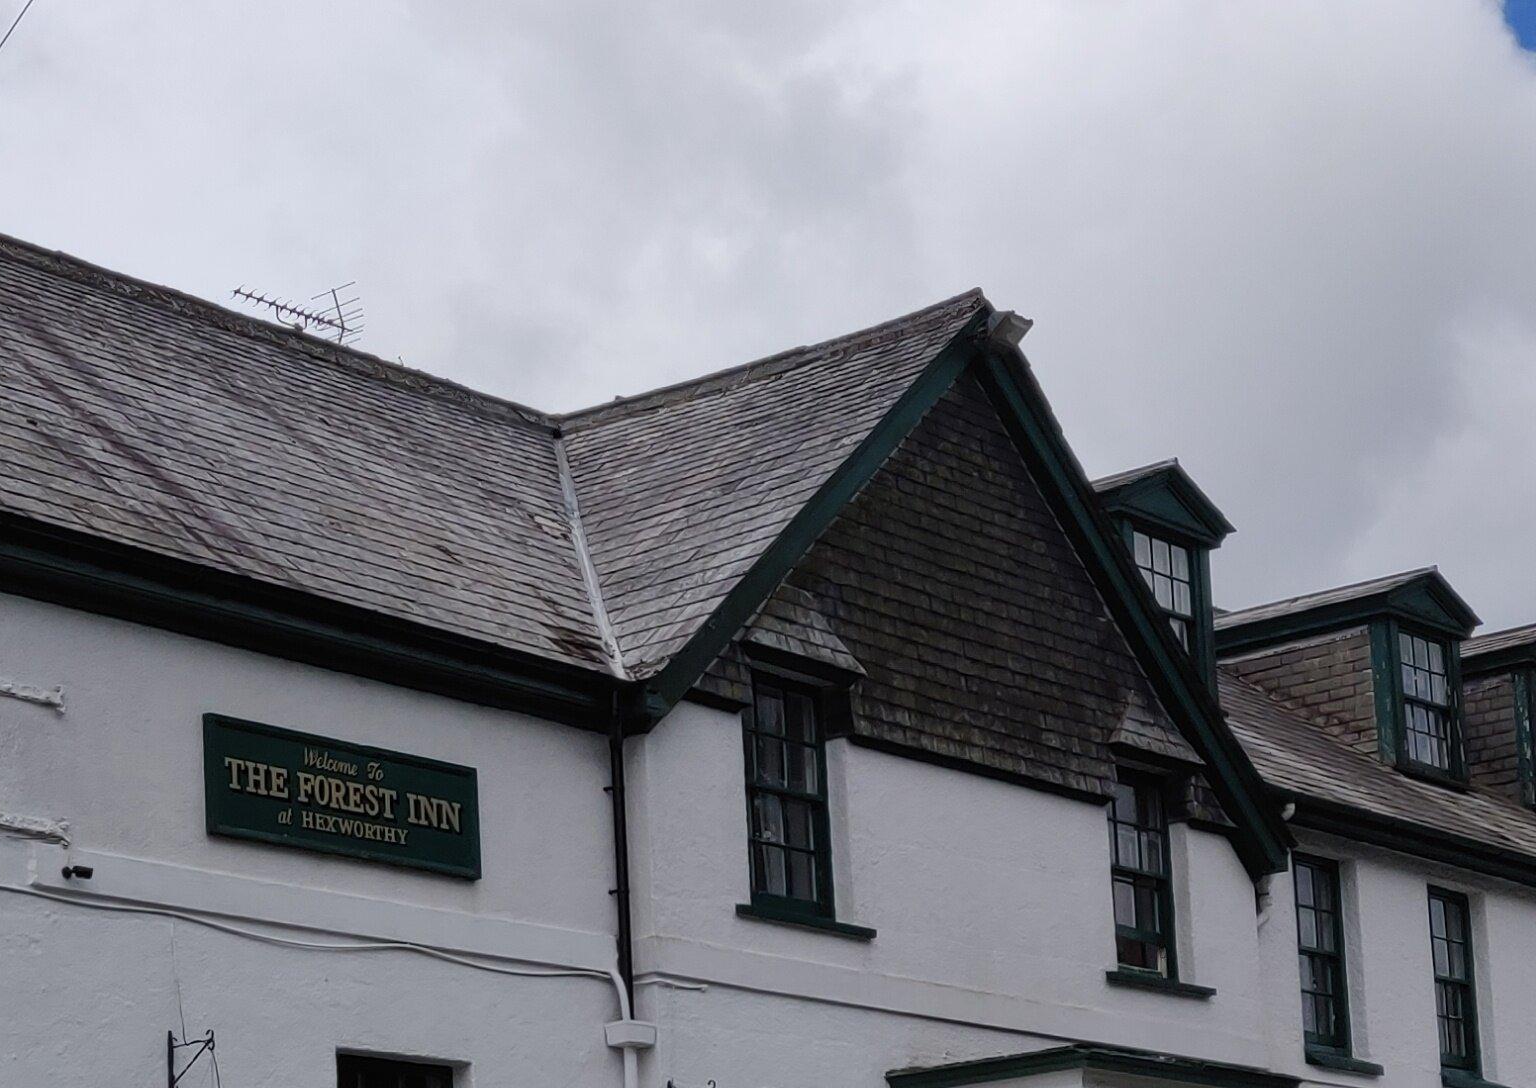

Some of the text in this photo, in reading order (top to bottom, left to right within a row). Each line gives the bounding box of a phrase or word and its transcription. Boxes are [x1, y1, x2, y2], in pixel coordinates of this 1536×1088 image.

[304, 747, 385, 781] Welcome To
[224, 757, 462, 833] THE FOREST INN
[278, 808, 409, 845] at HEXWORTHY
